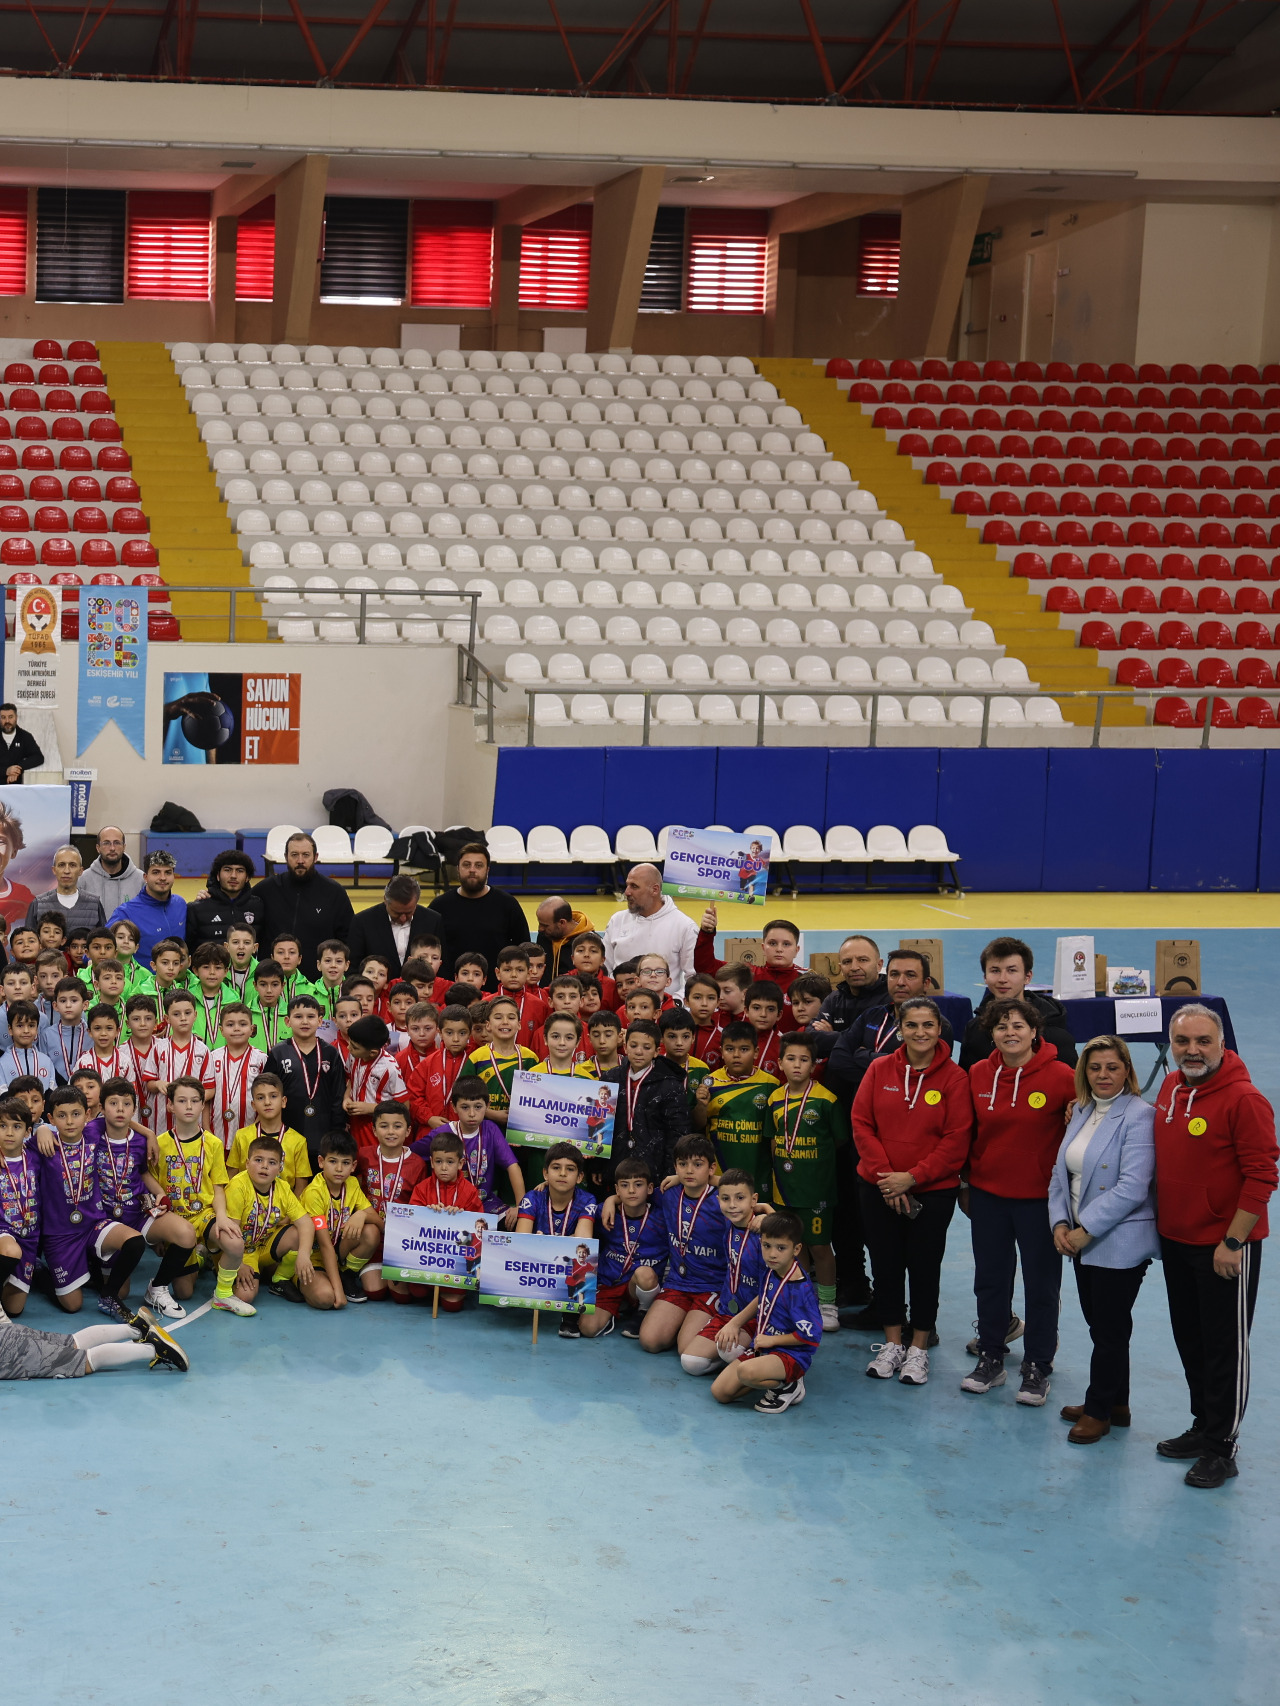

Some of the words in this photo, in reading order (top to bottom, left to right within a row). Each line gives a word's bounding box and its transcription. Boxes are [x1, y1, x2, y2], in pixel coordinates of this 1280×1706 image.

[87, 669, 124, 678] ESKİŞEHİR
[125, 670, 139, 678] YILI
[246, 678, 290, 702] SAVUN
[245, 704, 290, 731] HÜCUM
[245, 736, 260, 760] ET
[78, 784, 87, 818] molten
[670, 850, 762, 872] GENÇLERGÜCÜ
[697, 867, 731, 880] SPOR
[1120, 1011, 1158, 1020] GENÇLERGÜCÜ
[214, 1060, 220, 1073] 9
[281, 1058, 292, 1074] 12
[518, 1096, 610, 1118] IHLAMURKENT
[544, 1113, 579, 1128] SPOR
[812, 1216, 822, 1234] 8
[419, 1226, 460, 1242] MİNİK
[401, 1237, 476, 1258] ŞİMŞEKLER
[694, 1245, 717, 1257] YAPI
[419, 1254, 456, 1270] SPOR
[504, 1260, 574, 1276] ESENTEPE
[518, 1276, 557, 1288] SPOR
